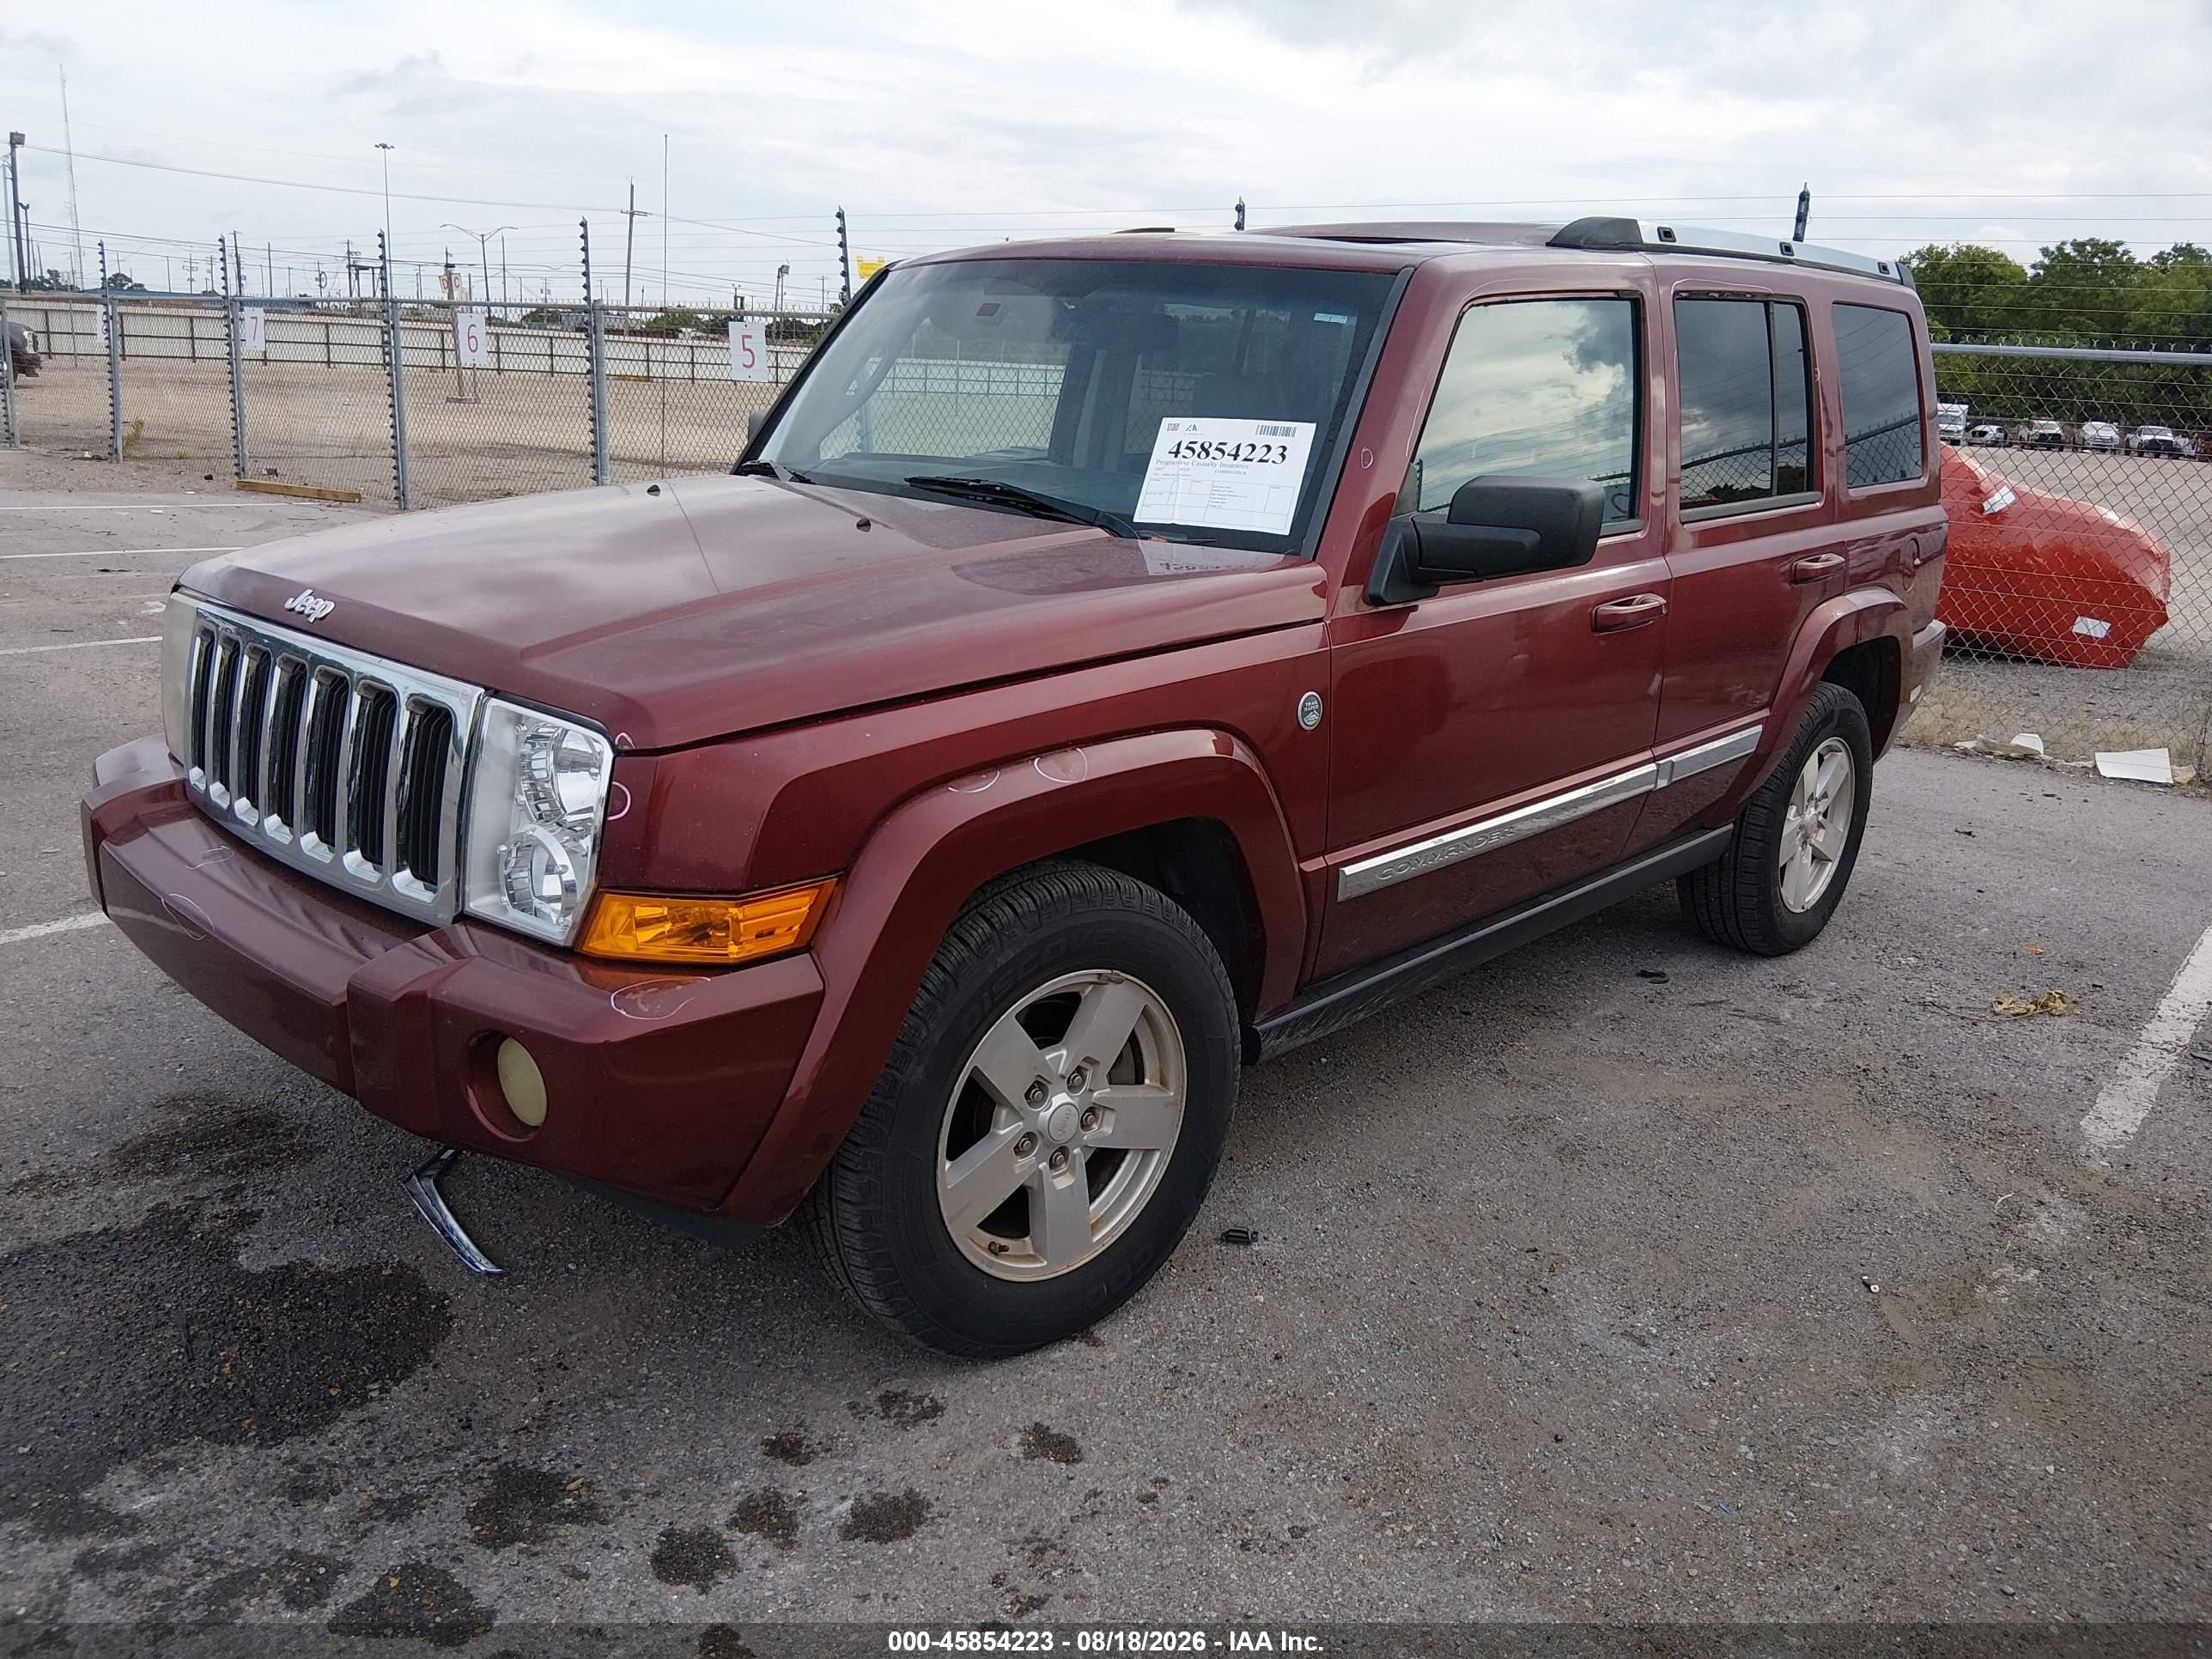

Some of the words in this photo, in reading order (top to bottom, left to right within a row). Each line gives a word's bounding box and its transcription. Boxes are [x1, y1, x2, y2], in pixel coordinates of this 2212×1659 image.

[250, 316, 258, 342] 7
[466, 323, 478, 353] 6
[741, 334, 756, 369] 5
[1168, 440, 1288, 465] 45854223
[1219, 461, 1249, 470] Insurance
[284, 588, 335, 623] Jeep
[1376, 827, 1516, 880] COMMANDER
